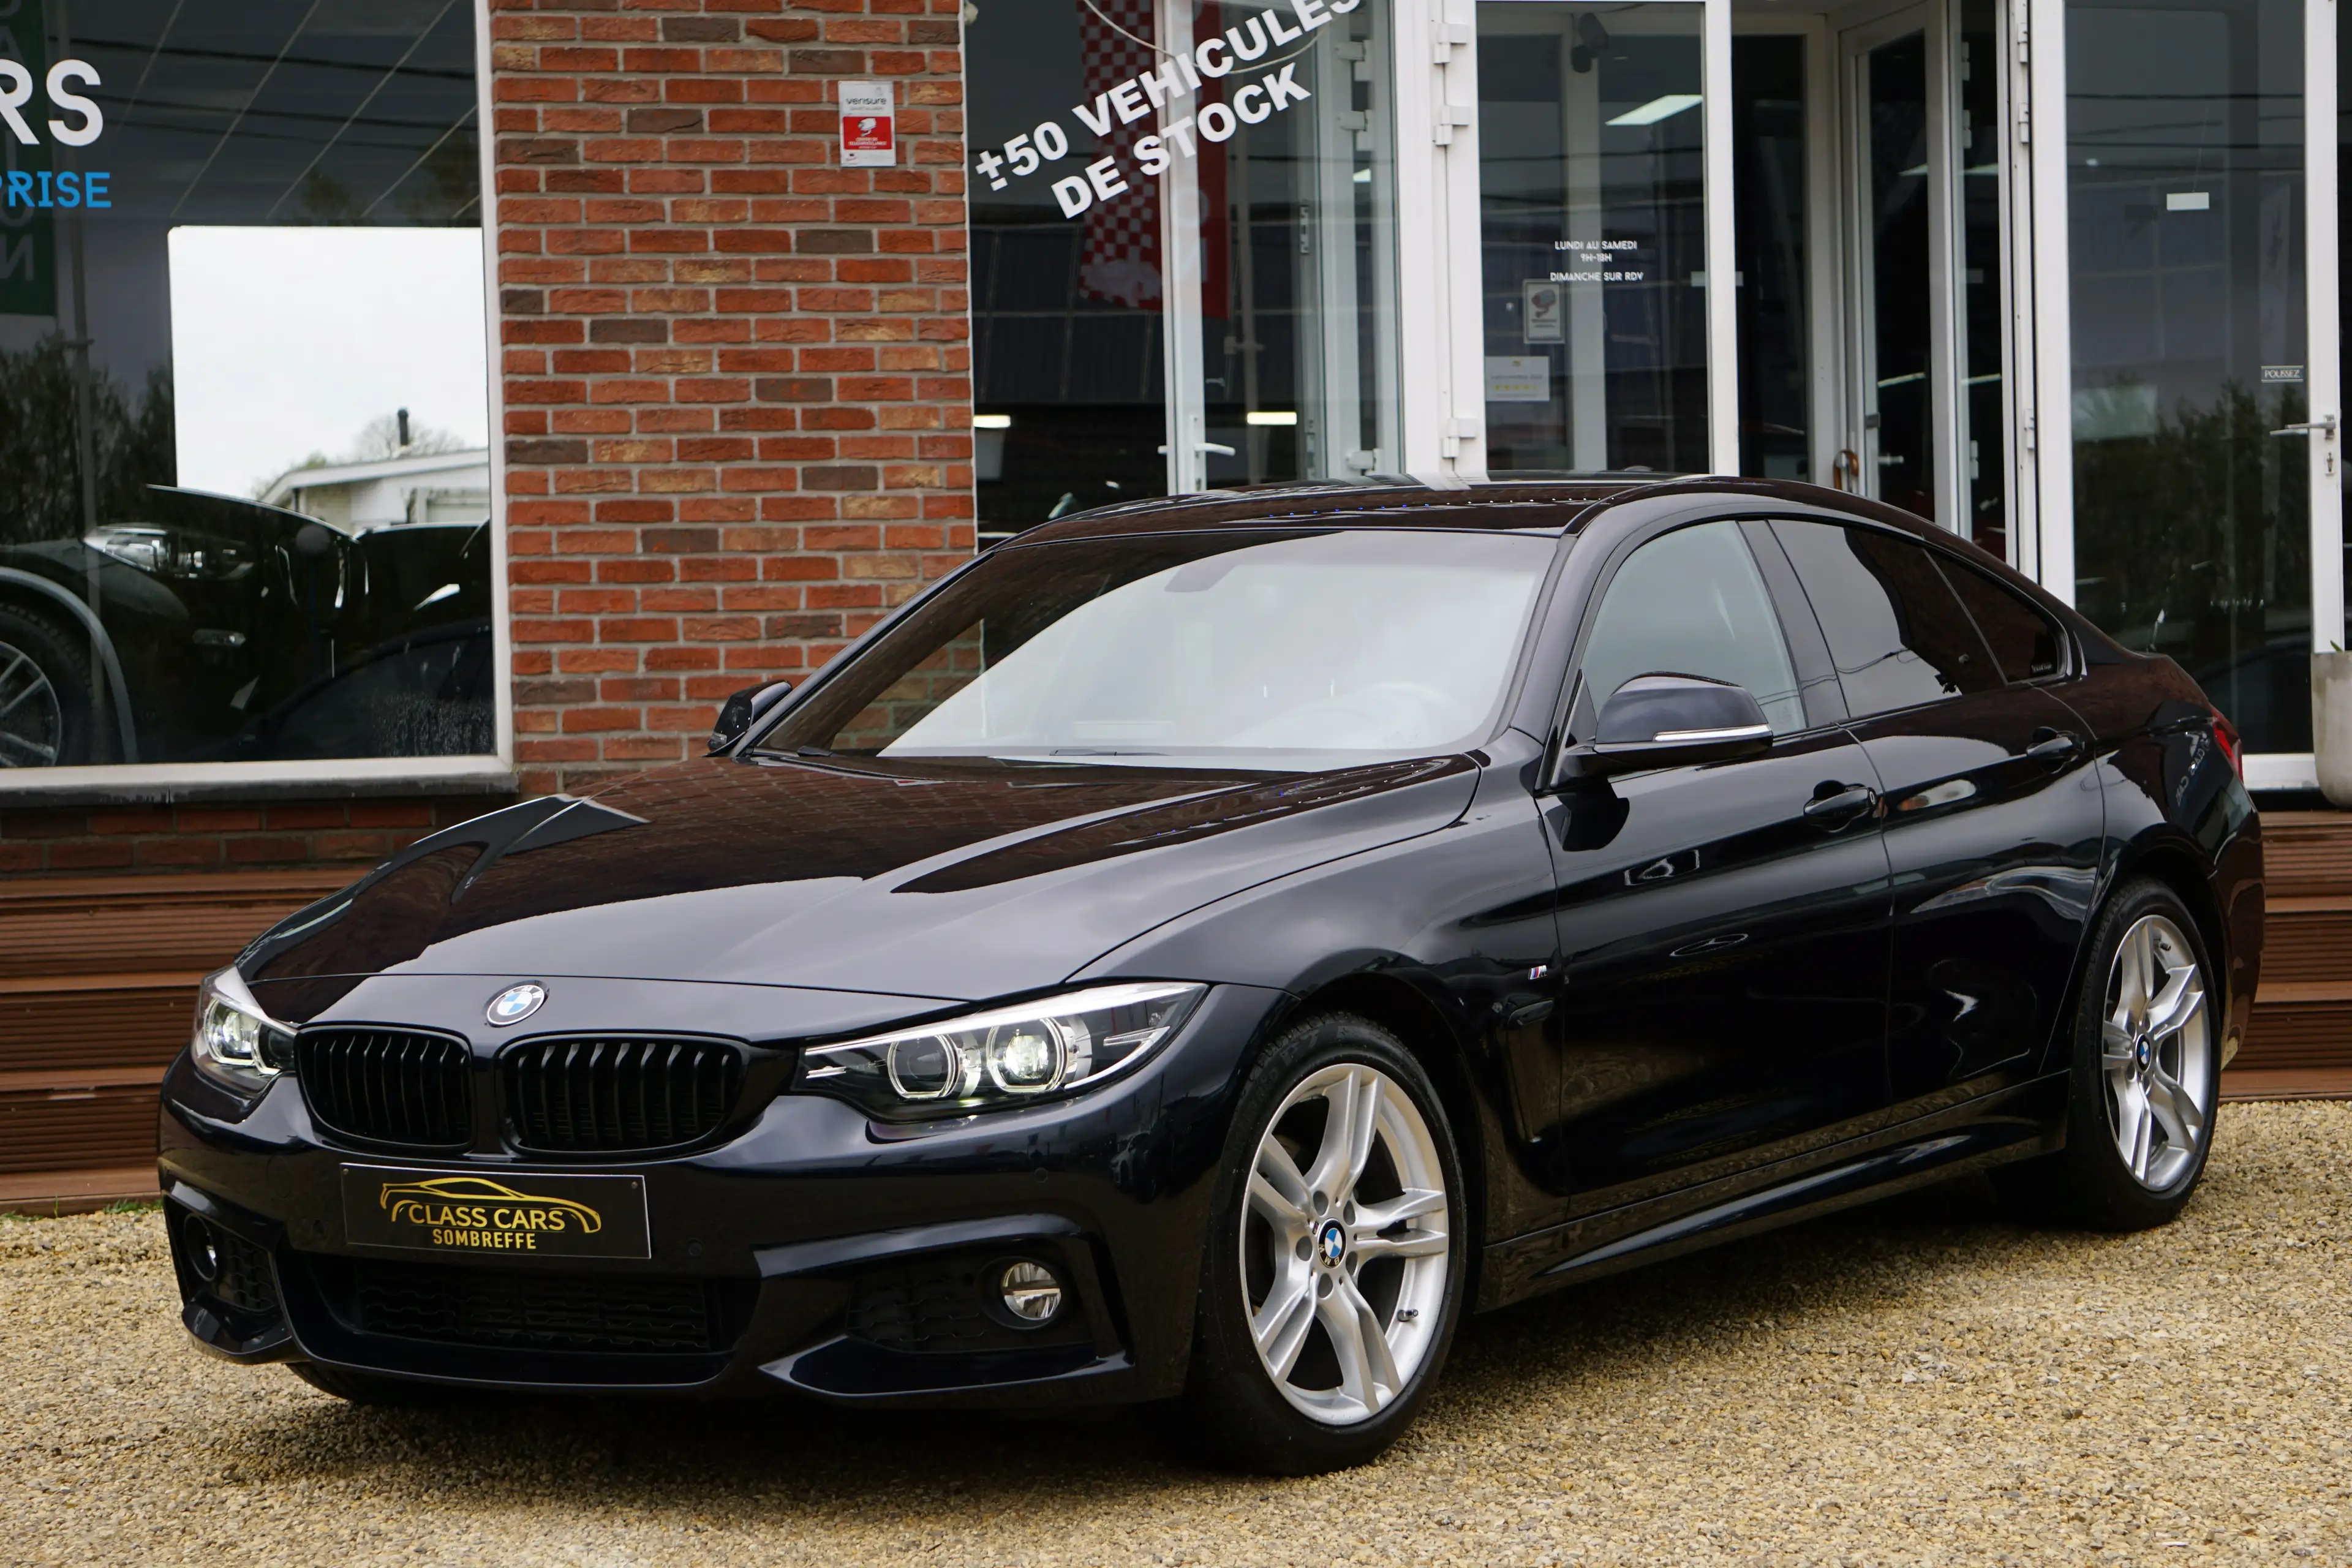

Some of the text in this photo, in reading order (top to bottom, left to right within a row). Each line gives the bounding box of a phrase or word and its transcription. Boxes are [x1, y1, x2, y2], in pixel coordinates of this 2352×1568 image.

[1050, 62, 1311, 219] DE STOCK
[0, 170, 112, 209] RISE
[1555, 241, 1638, 250] LUNDI AU SAMEDI
[1580, 252, 1612, 262] 9H-18H
[1550, 271, 1644, 281] DIMANCHE SUR RDV
[2264, 369, 2300, 379] POUSSEZ
[408, 1203, 566, 1231] CLASS CARS
[432, 1228, 537, 1250] SOMBREFFE
[1319, 1243, 1340, 1266] BMW
